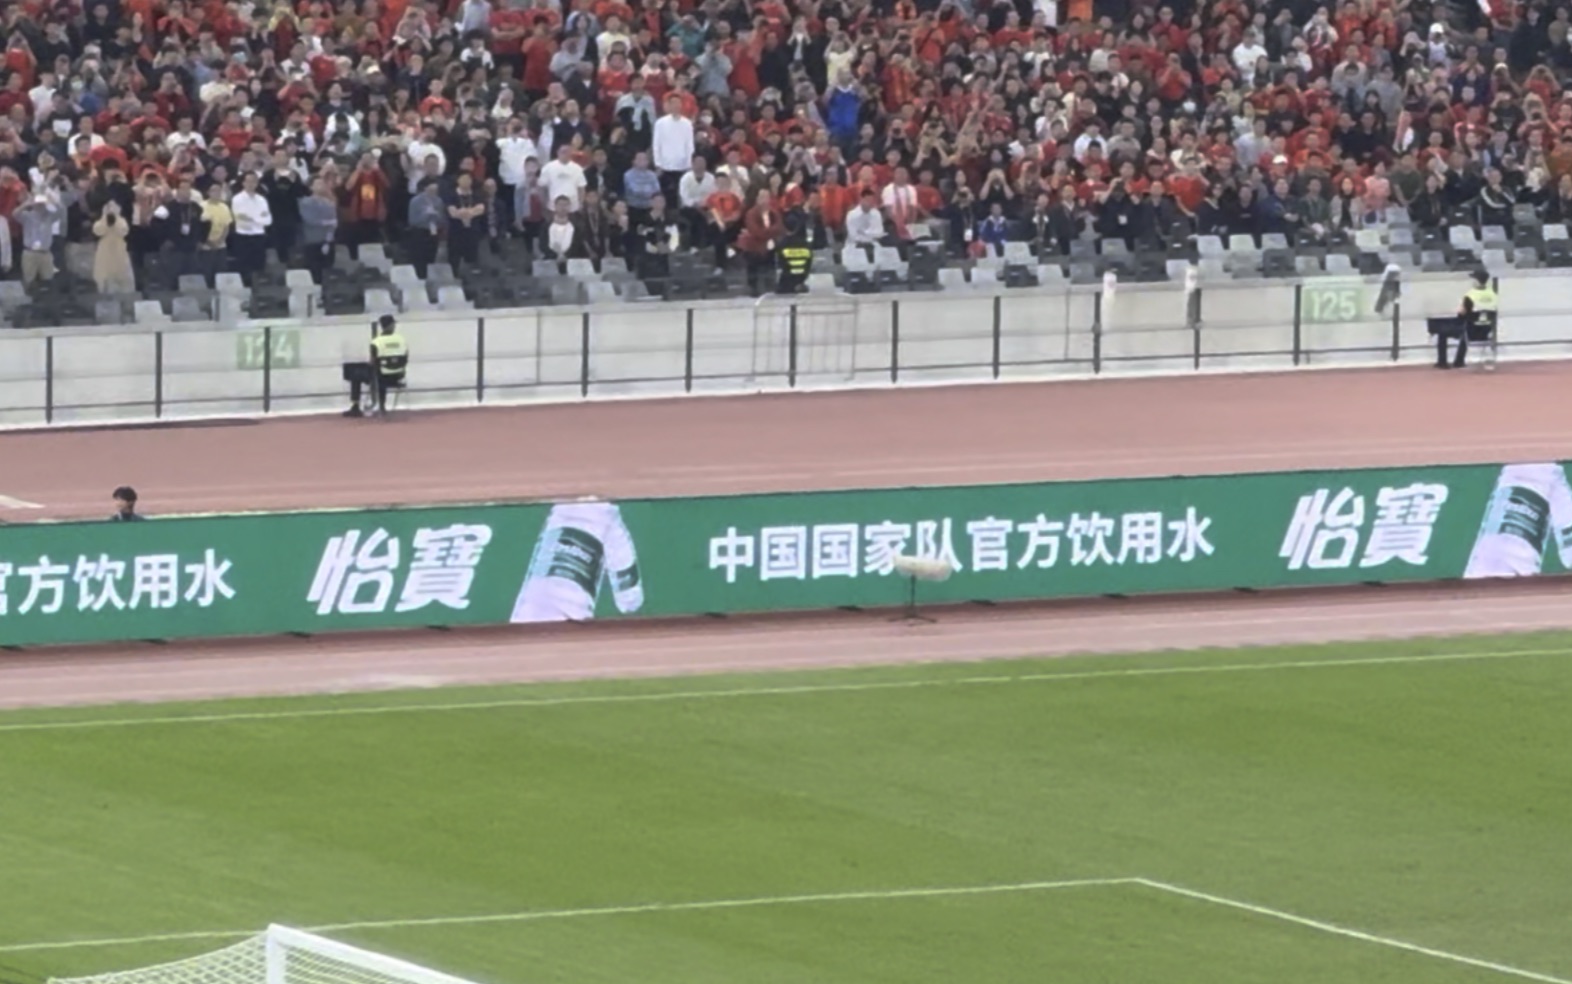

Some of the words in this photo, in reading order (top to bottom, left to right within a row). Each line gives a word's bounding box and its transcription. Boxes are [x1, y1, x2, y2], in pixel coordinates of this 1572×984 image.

[1311, 290, 1356, 321] 125
[708, 507, 1214, 583] 中国国家队官方饮用水
[1279, 483, 1449, 570] 怡寶
[0, 548, 236, 616] 方饮用水
[306, 523, 493, 615] 怡寶
